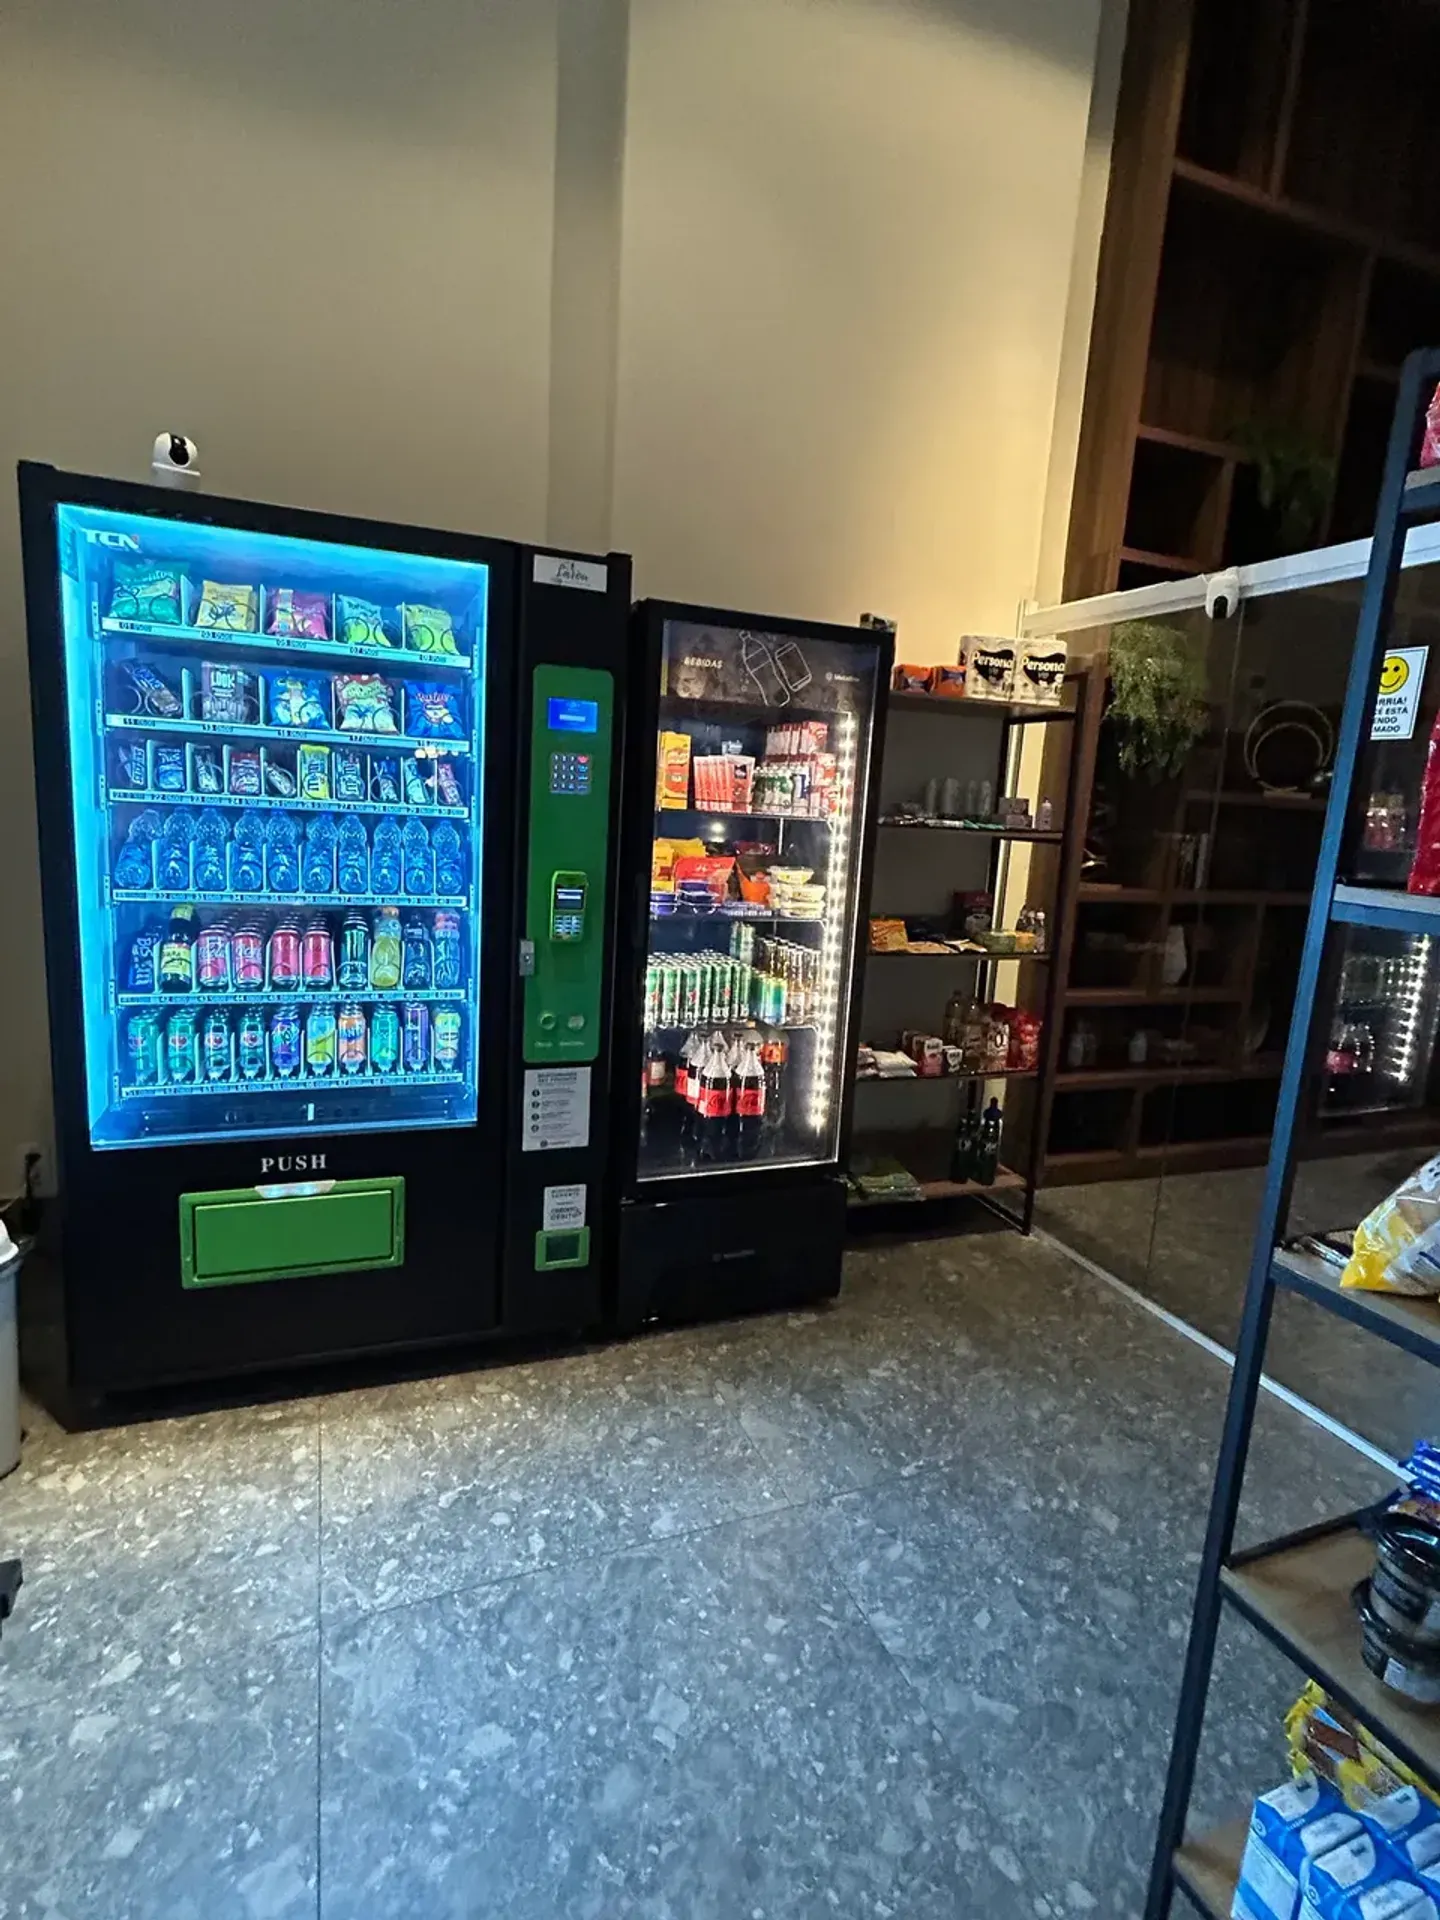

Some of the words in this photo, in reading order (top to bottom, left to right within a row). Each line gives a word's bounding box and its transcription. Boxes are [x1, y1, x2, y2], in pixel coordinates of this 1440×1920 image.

[683, 656, 723, 669] BEBIDAS
[972, 651, 1013, 669] Persona
[1022, 655, 1066, 672] Persona
[1378, 696, 1407, 706] RRIA!
[1373, 725, 1401, 733] MADO
[261, 1153, 327, 1173] PUSH
